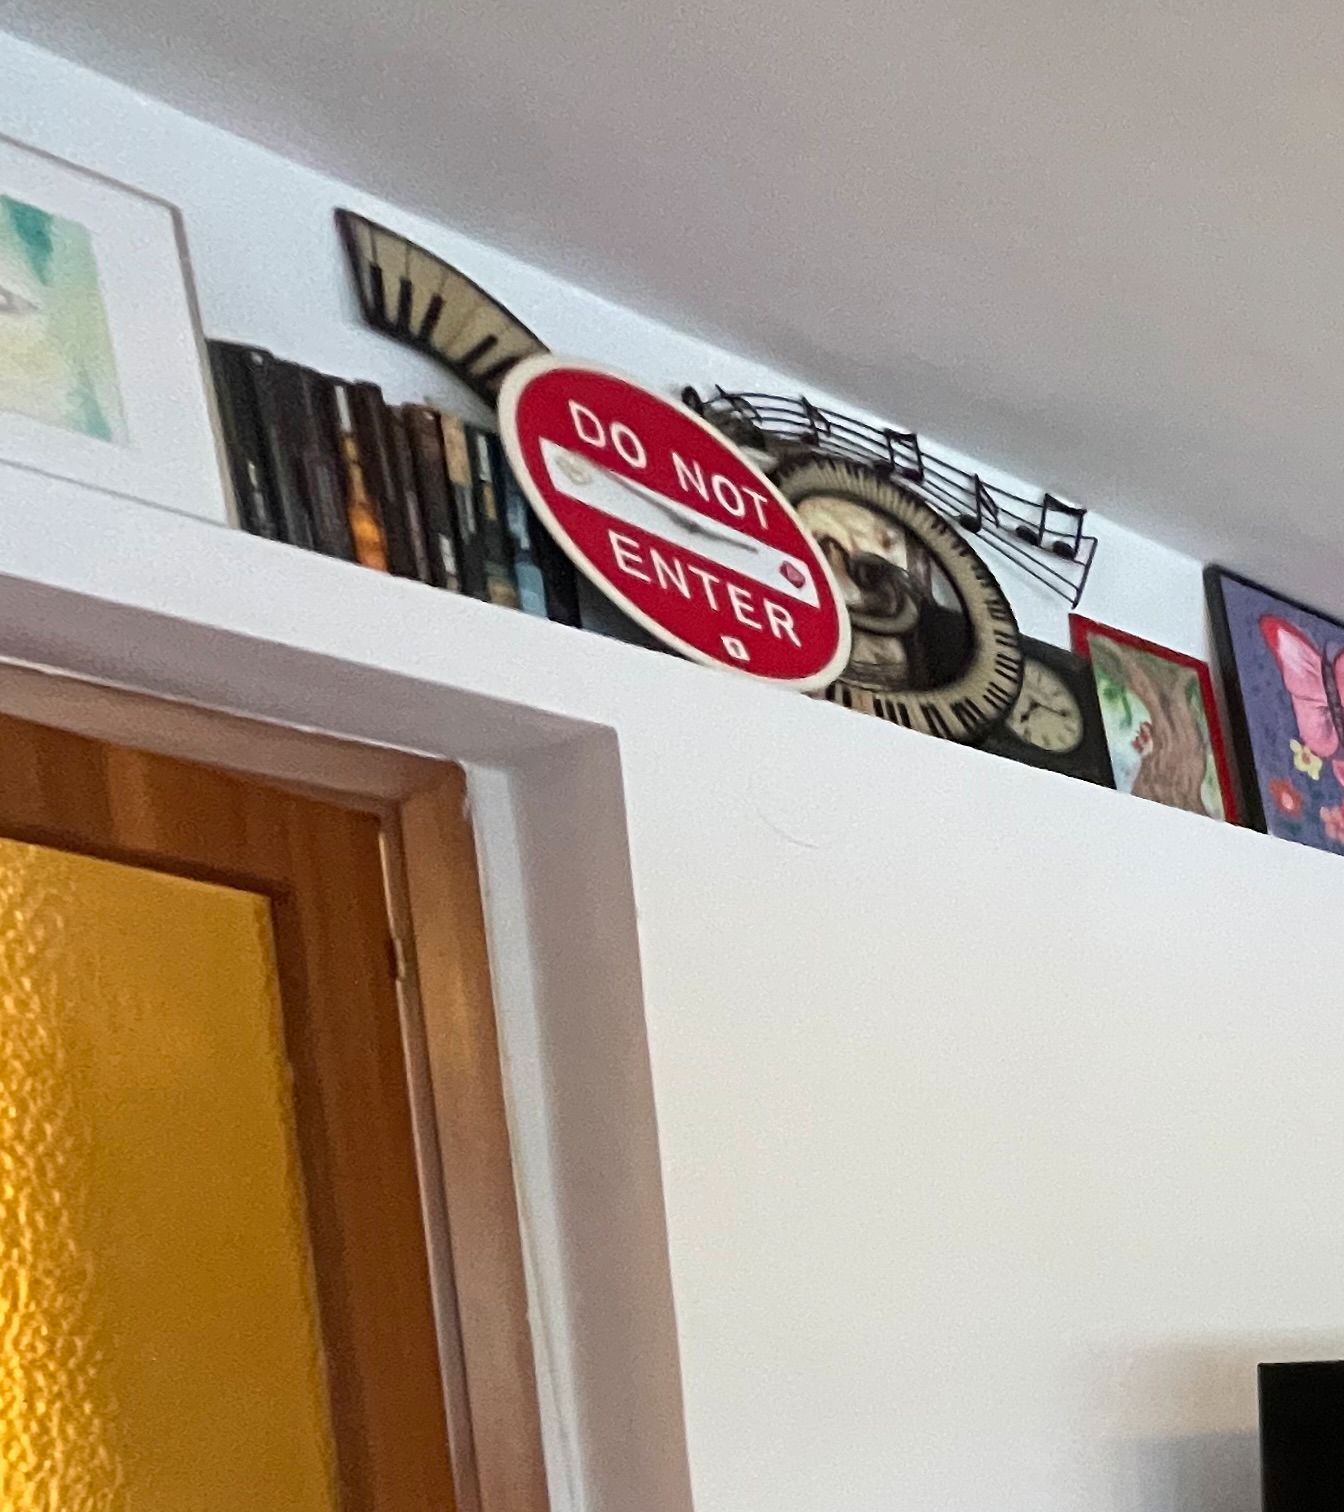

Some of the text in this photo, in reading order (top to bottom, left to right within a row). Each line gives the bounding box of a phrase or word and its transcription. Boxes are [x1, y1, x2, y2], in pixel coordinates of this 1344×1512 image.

[568, 399, 768, 530] DO NOT
[607, 528, 802, 648] ENTER
